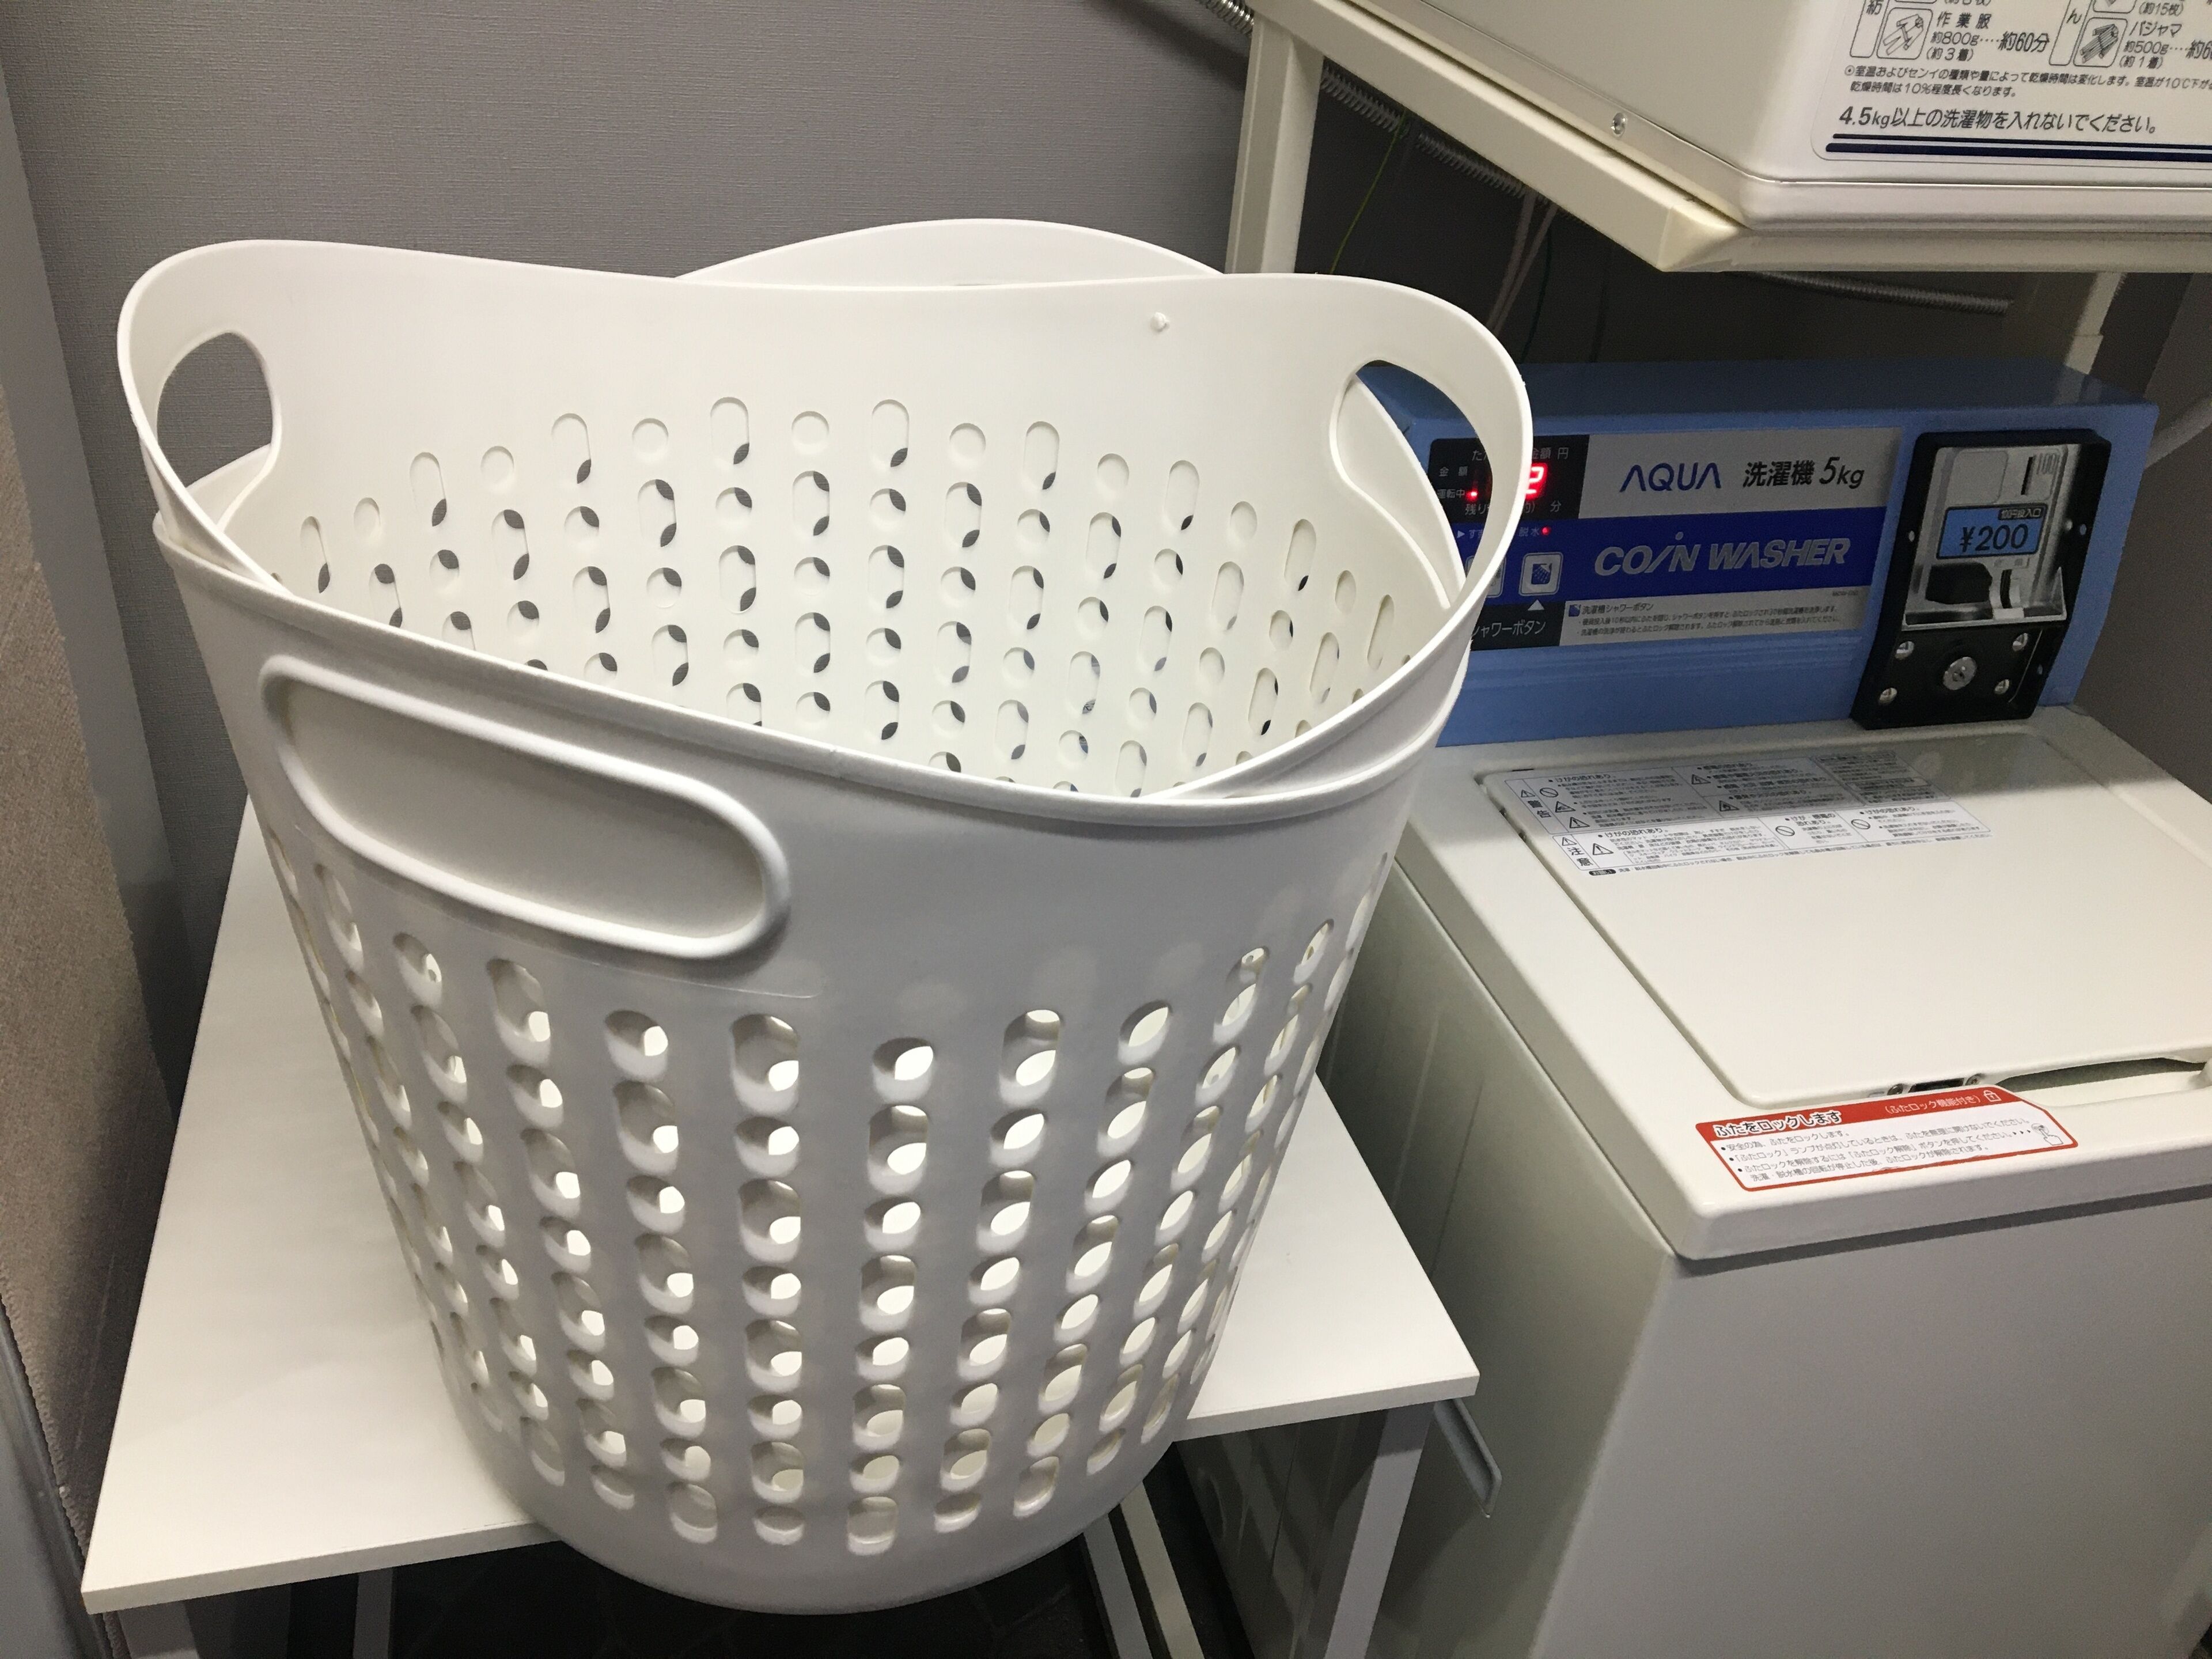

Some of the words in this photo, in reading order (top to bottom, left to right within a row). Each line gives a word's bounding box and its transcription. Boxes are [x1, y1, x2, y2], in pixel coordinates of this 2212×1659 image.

[1937, 12, 1992, 29] 作業服
[2129, 21, 2182, 37] パジャマ
[1998, 31, 2049, 52] 約60分
[2186, 39, 2212, 60] 約6
[1619, 463, 1722, 493] AQUA
[1743, 460, 1815, 488] 洗濯機
[1960, 525, 2028, 552] ¥200
[1709, 538, 1851, 570] WASHER
[1715, 1111, 1841, 1137] ふたをロックします
